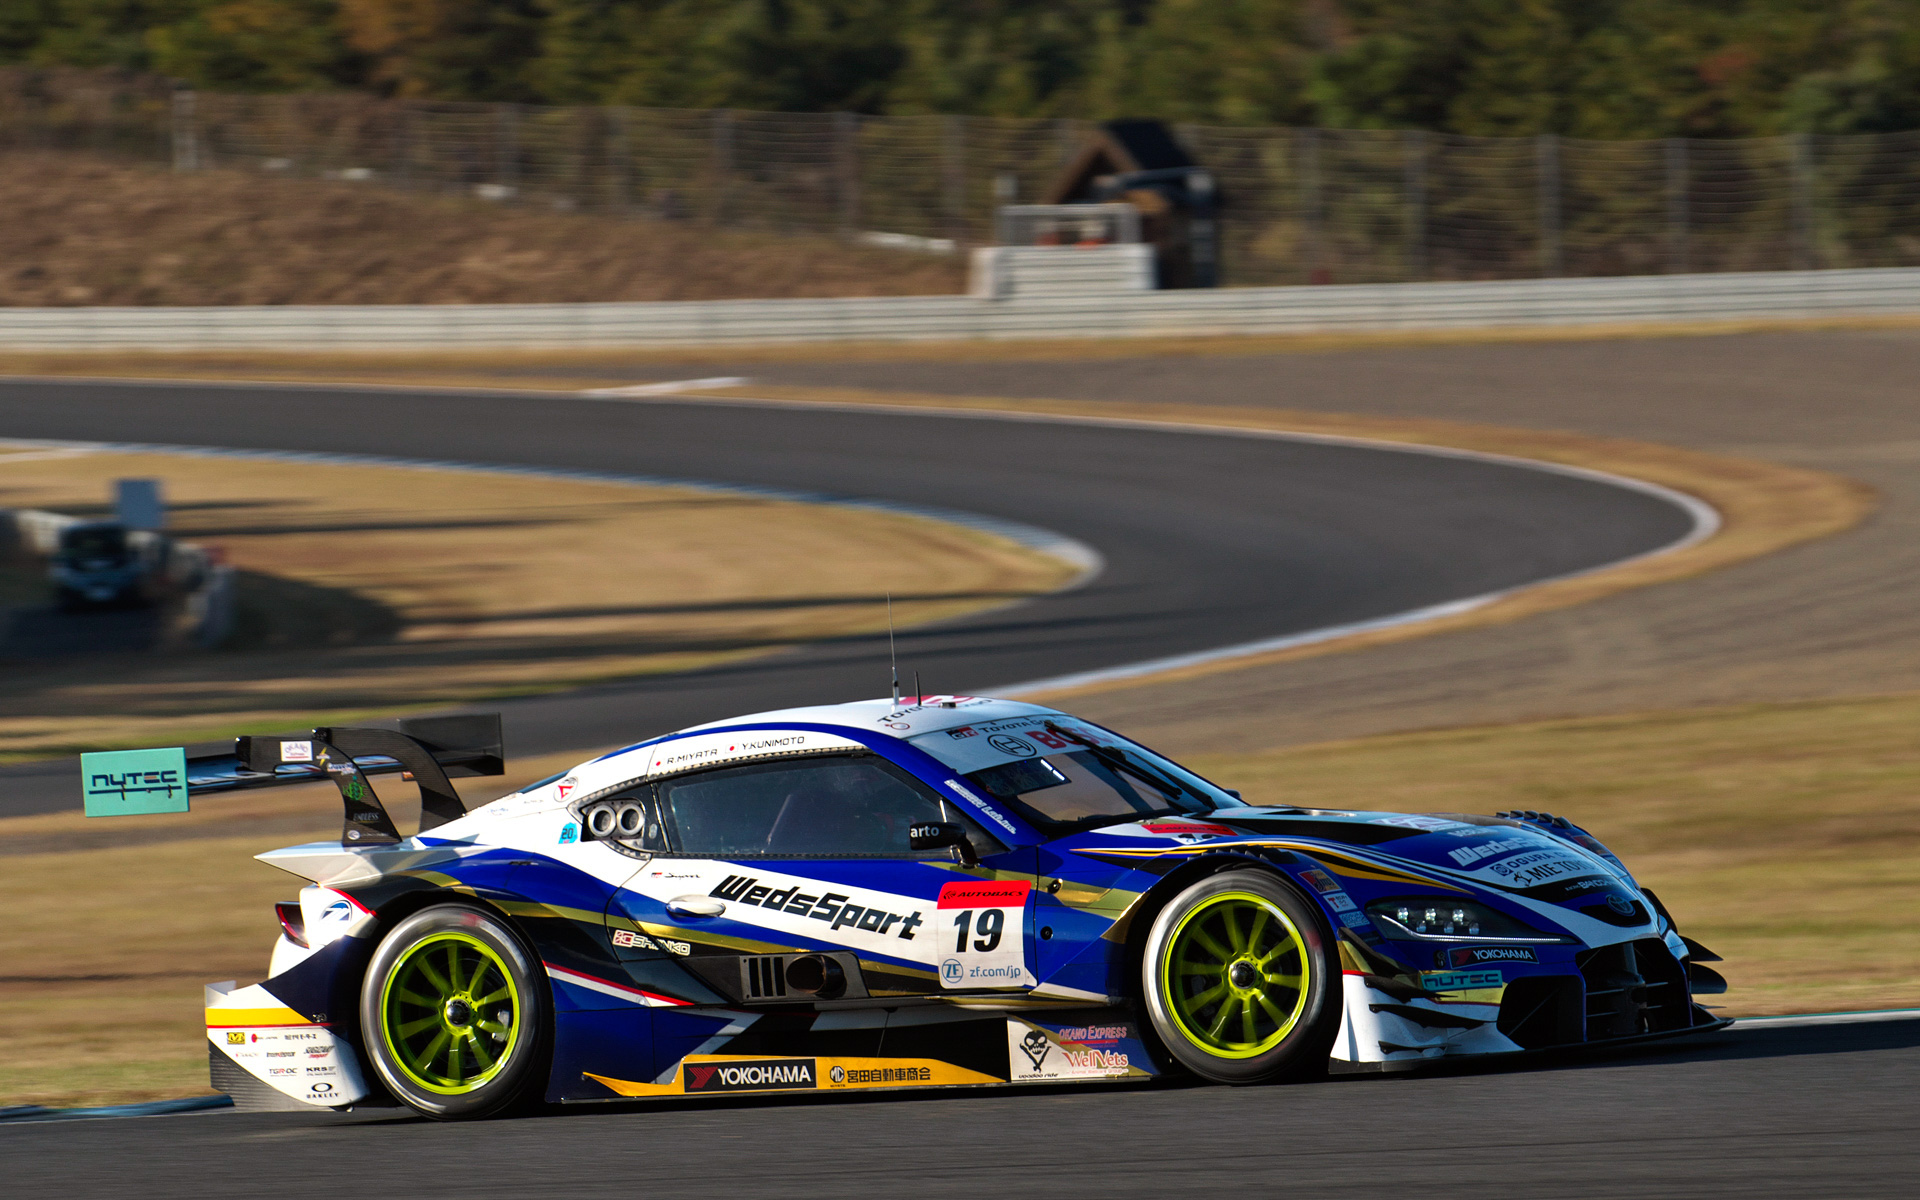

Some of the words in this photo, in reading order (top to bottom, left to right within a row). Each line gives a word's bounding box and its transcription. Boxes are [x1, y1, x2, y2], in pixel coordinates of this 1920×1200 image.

[978, 721, 1030, 733] TOYOTA
[742, 736, 805, 751] Y.KUNIMOTO
[666, 748, 718, 765] R.MIYATA
[562, 828, 574, 839] 20
[910, 825, 940, 838] arto
[1506, 852, 1553, 869] OGURA
[1530, 863, 1563, 881] MIE
[957, 890, 1025, 898] AUTOBACS
[708, 874, 924, 941] WedsSport
[953, 908, 1005, 953] 19
[1473, 949, 1533, 960] YOKOHAMA
[943, 963, 963, 979] ZF
[969, 965, 1021, 979] zf.com/jp
[1058, 1028, 1087, 1040] OKANO
[1088, 1025, 1128, 1039] EXPRESS
[717, 1065, 812, 1085] YOKOHAMA
[847, 1066, 931, 1084] 宮田自動車商会
